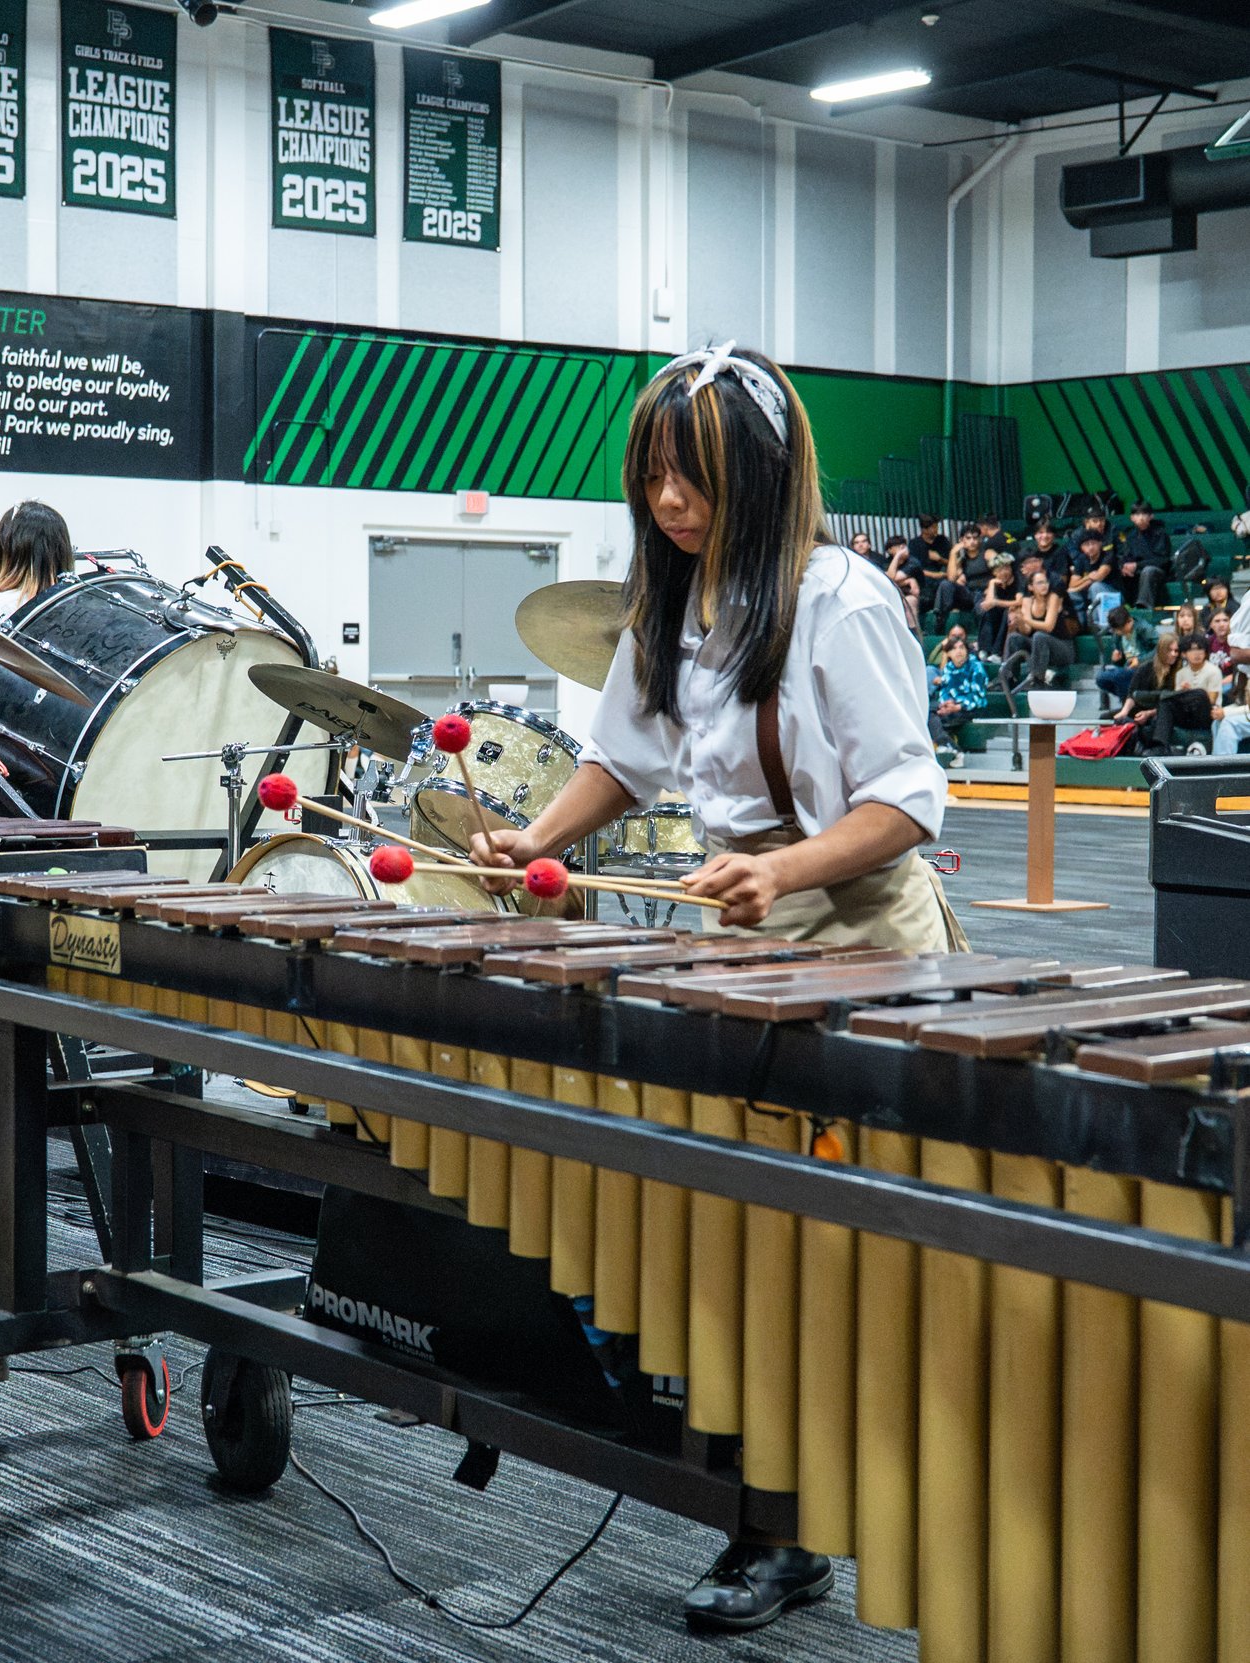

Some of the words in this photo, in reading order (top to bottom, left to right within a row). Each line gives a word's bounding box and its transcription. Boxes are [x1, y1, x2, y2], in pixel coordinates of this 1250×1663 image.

[75, 44, 101, 59] GIRLS
[102, 48, 130, 64] TRACK
[137, 55, 163, 70] FIELD
[68, 66, 170, 114] LEAGUE
[301, 78, 346, 95] SOFTBALL
[416, 93, 445, 108] LEAGUE
[447, 98, 490, 114] CHAMPIONS
[68, 101, 170, 152] CHAMPIONS
[277, 96, 370, 138] LEAGUE
[277, 130, 370, 174] CHAMPIONS
[72, 148, 167, 205] 2025
[282, 173, 367, 225] 2025
[422, 207, 481, 242] 2025
[1, 345, 62, 369] faithful
[64, 355, 88, 371] we
[91, 353, 120, 373] will
[121, 355, 145, 378] be,
[6, 371, 24, 389] to
[26, 371, 83, 397] pledge
[85, 379, 113, 394] our
[116, 377, 171, 402] loyalty,
[13, 392, 35, 412] do
[38, 399, 68, 414] our
[69, 399, 109, 419] part.
[4, 414, 44, 435] Park
[46, 420, 71, 437] we
[73, 420, 136, 444] proudly
[137, 424, 174, 447] sing,
[51, 915, 119, 969] Dynasty
[311, 1282, 436, 1352] PROMARK
